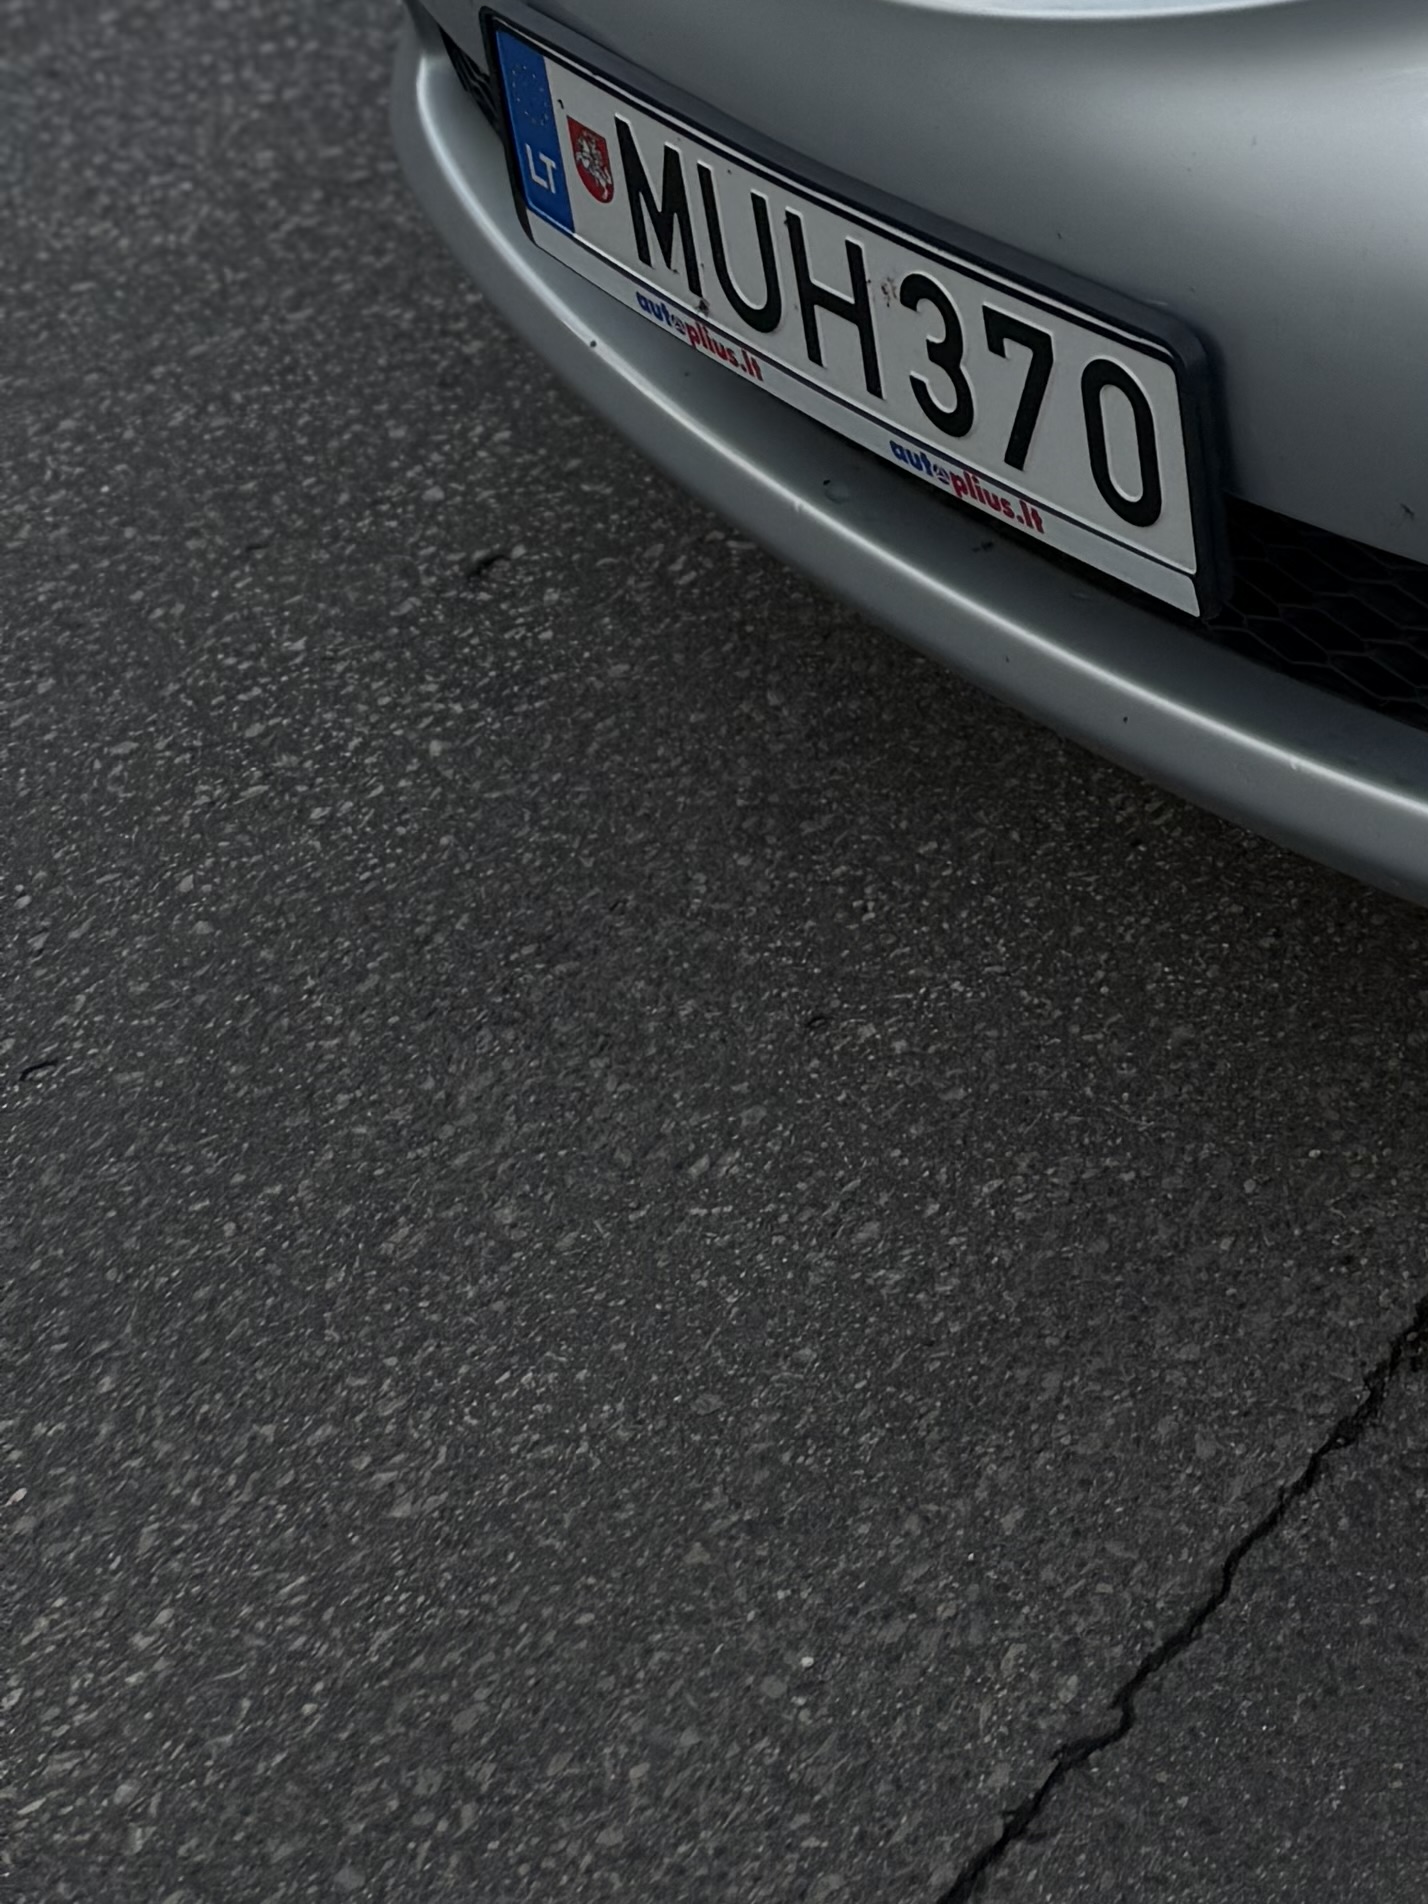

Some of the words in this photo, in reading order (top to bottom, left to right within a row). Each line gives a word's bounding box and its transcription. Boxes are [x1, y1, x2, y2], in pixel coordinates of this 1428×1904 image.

[525, 143, 557, 194] LT
[636, 291, 764, 382] autoplius.lt
[889, 439, 1045, 534] autoplius.lt
